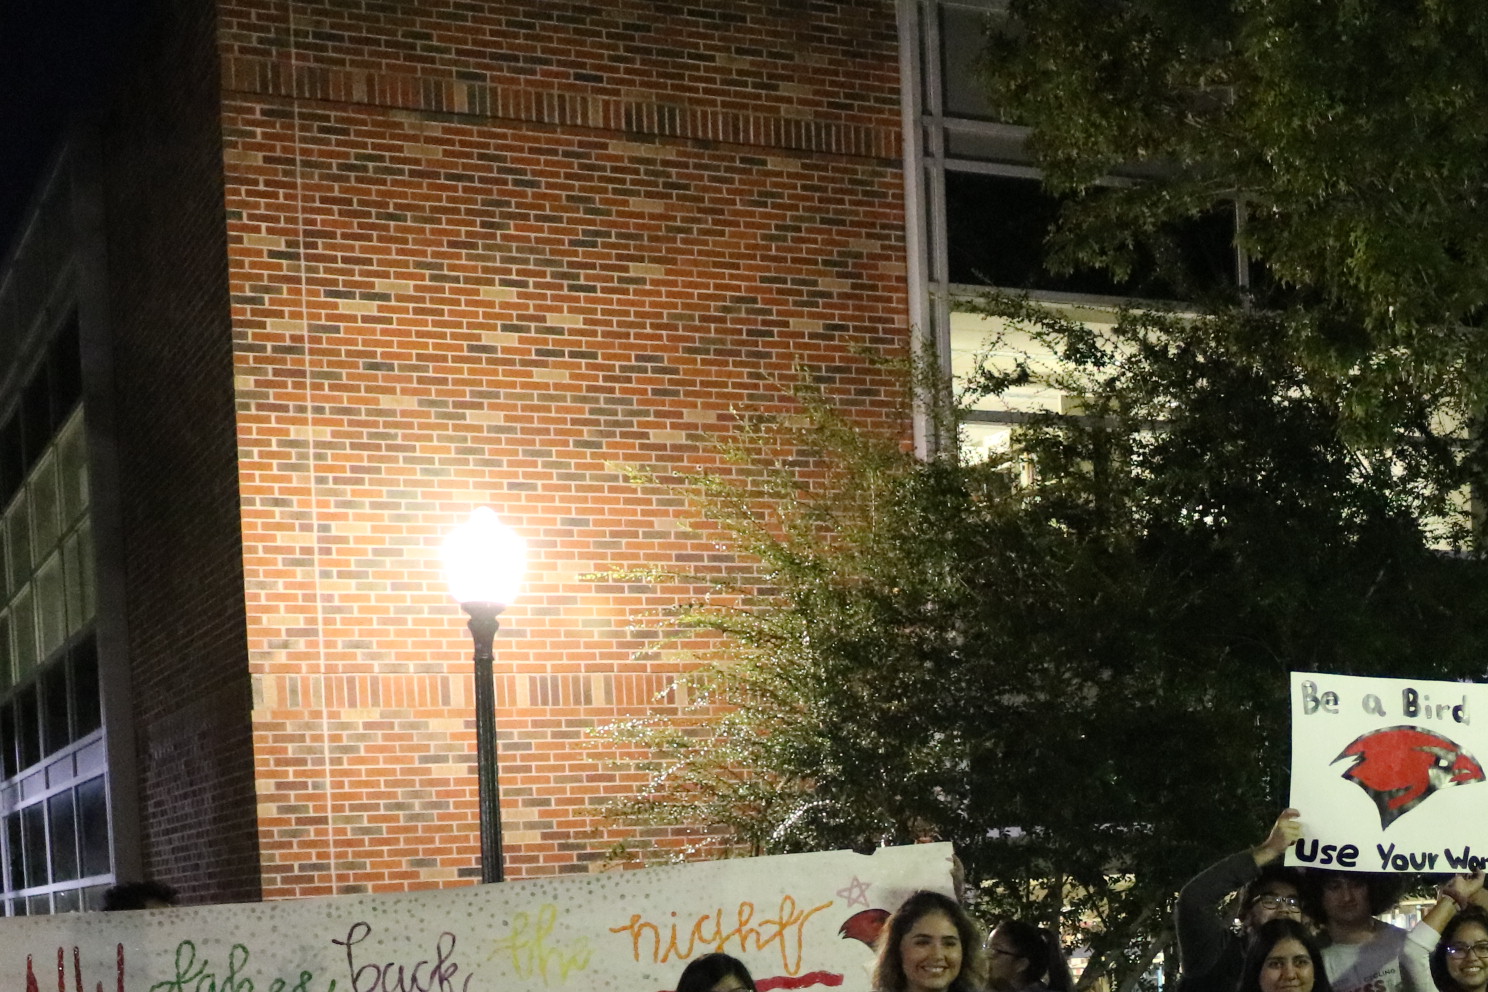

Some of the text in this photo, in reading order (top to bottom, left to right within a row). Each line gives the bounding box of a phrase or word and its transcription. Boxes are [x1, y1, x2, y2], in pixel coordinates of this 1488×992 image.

[1301, 680, 1471, 726] Be a Bird
[1295, 838, 1360, 868] Use
[1376, 842, 1440, 871] Your
[486, 904, 594, 986] the
[610, 895, 833, 976] night
